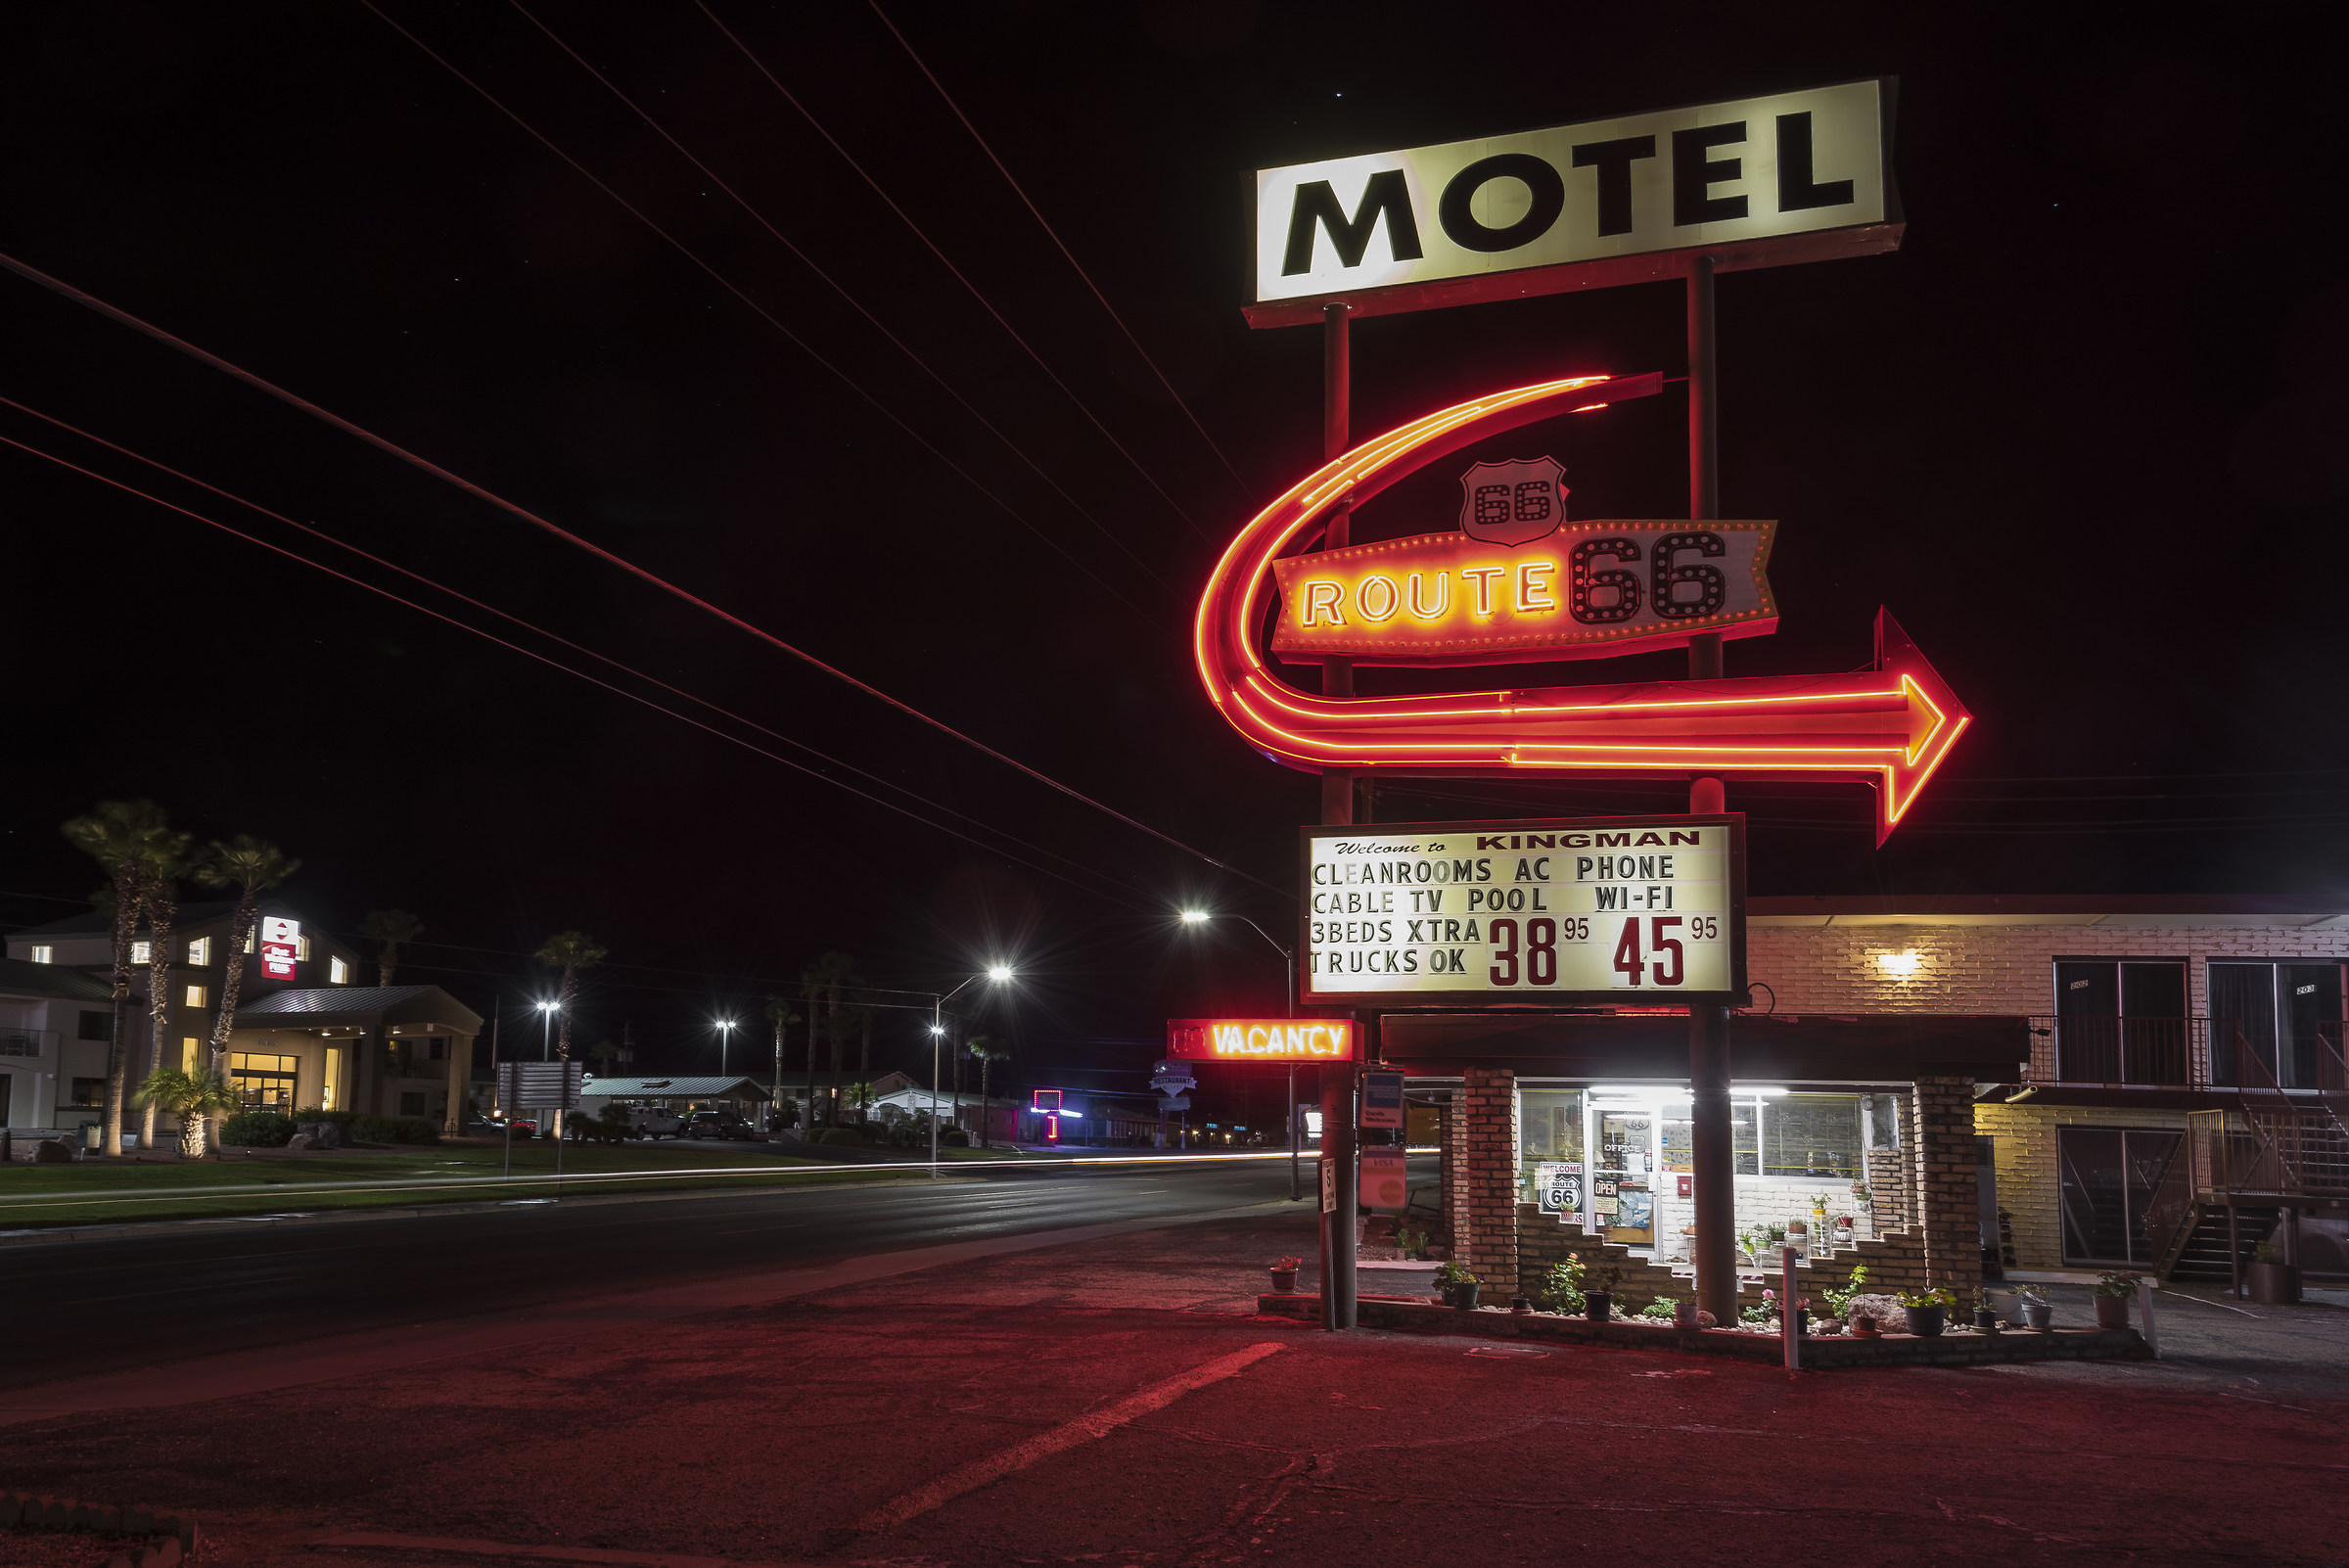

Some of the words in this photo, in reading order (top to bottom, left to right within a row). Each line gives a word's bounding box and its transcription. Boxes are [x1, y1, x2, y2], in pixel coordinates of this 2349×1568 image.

[1281, 111, 1854, 276] MOTEL
[1474, 480, 1551, 525] 66
[1302, 562, 1555, 628] ROUTE
[1568, 530, 1727, 624] 66
[1334, 842, 1420, 854] Welcome
[1427, 842, 1447, 853] to
[1476, 831, 1700, 851] KINGMAN
[1312, 858, 1492, 885] CLEANROOMS
[1514, 857, 1550, 881] AC
[1577, 855, 1674, 880] PHONE
[1312, 891, 1394, 914] CABLE
[1409, 890, 1443, 913] TV
[1467, 888, 1547, 912] POOL
[1594, 886, 1674, 910] WI-FI
[1312, 919, 1393, 944] 3BEDS
[1406, 918, 1481, 943] XTRA
[1311, 948, 1418, 974] TRUCKS
[1429, 947, 1466, 973] OK
[1489, 917, 1557, 987] 38
[1564, 917, 1589, 941] 95
[1613, 916, 1684, 987] 45
[1691, 916, 1718, 940] 95
[1213, 1024, 1347, 1055] VACANCY
[1543, 1165, 1582, 1174] WELCOME
[1550, 1189, 1574, 1205] 66
[1594, 1182, 1617, 1196] OPEN
